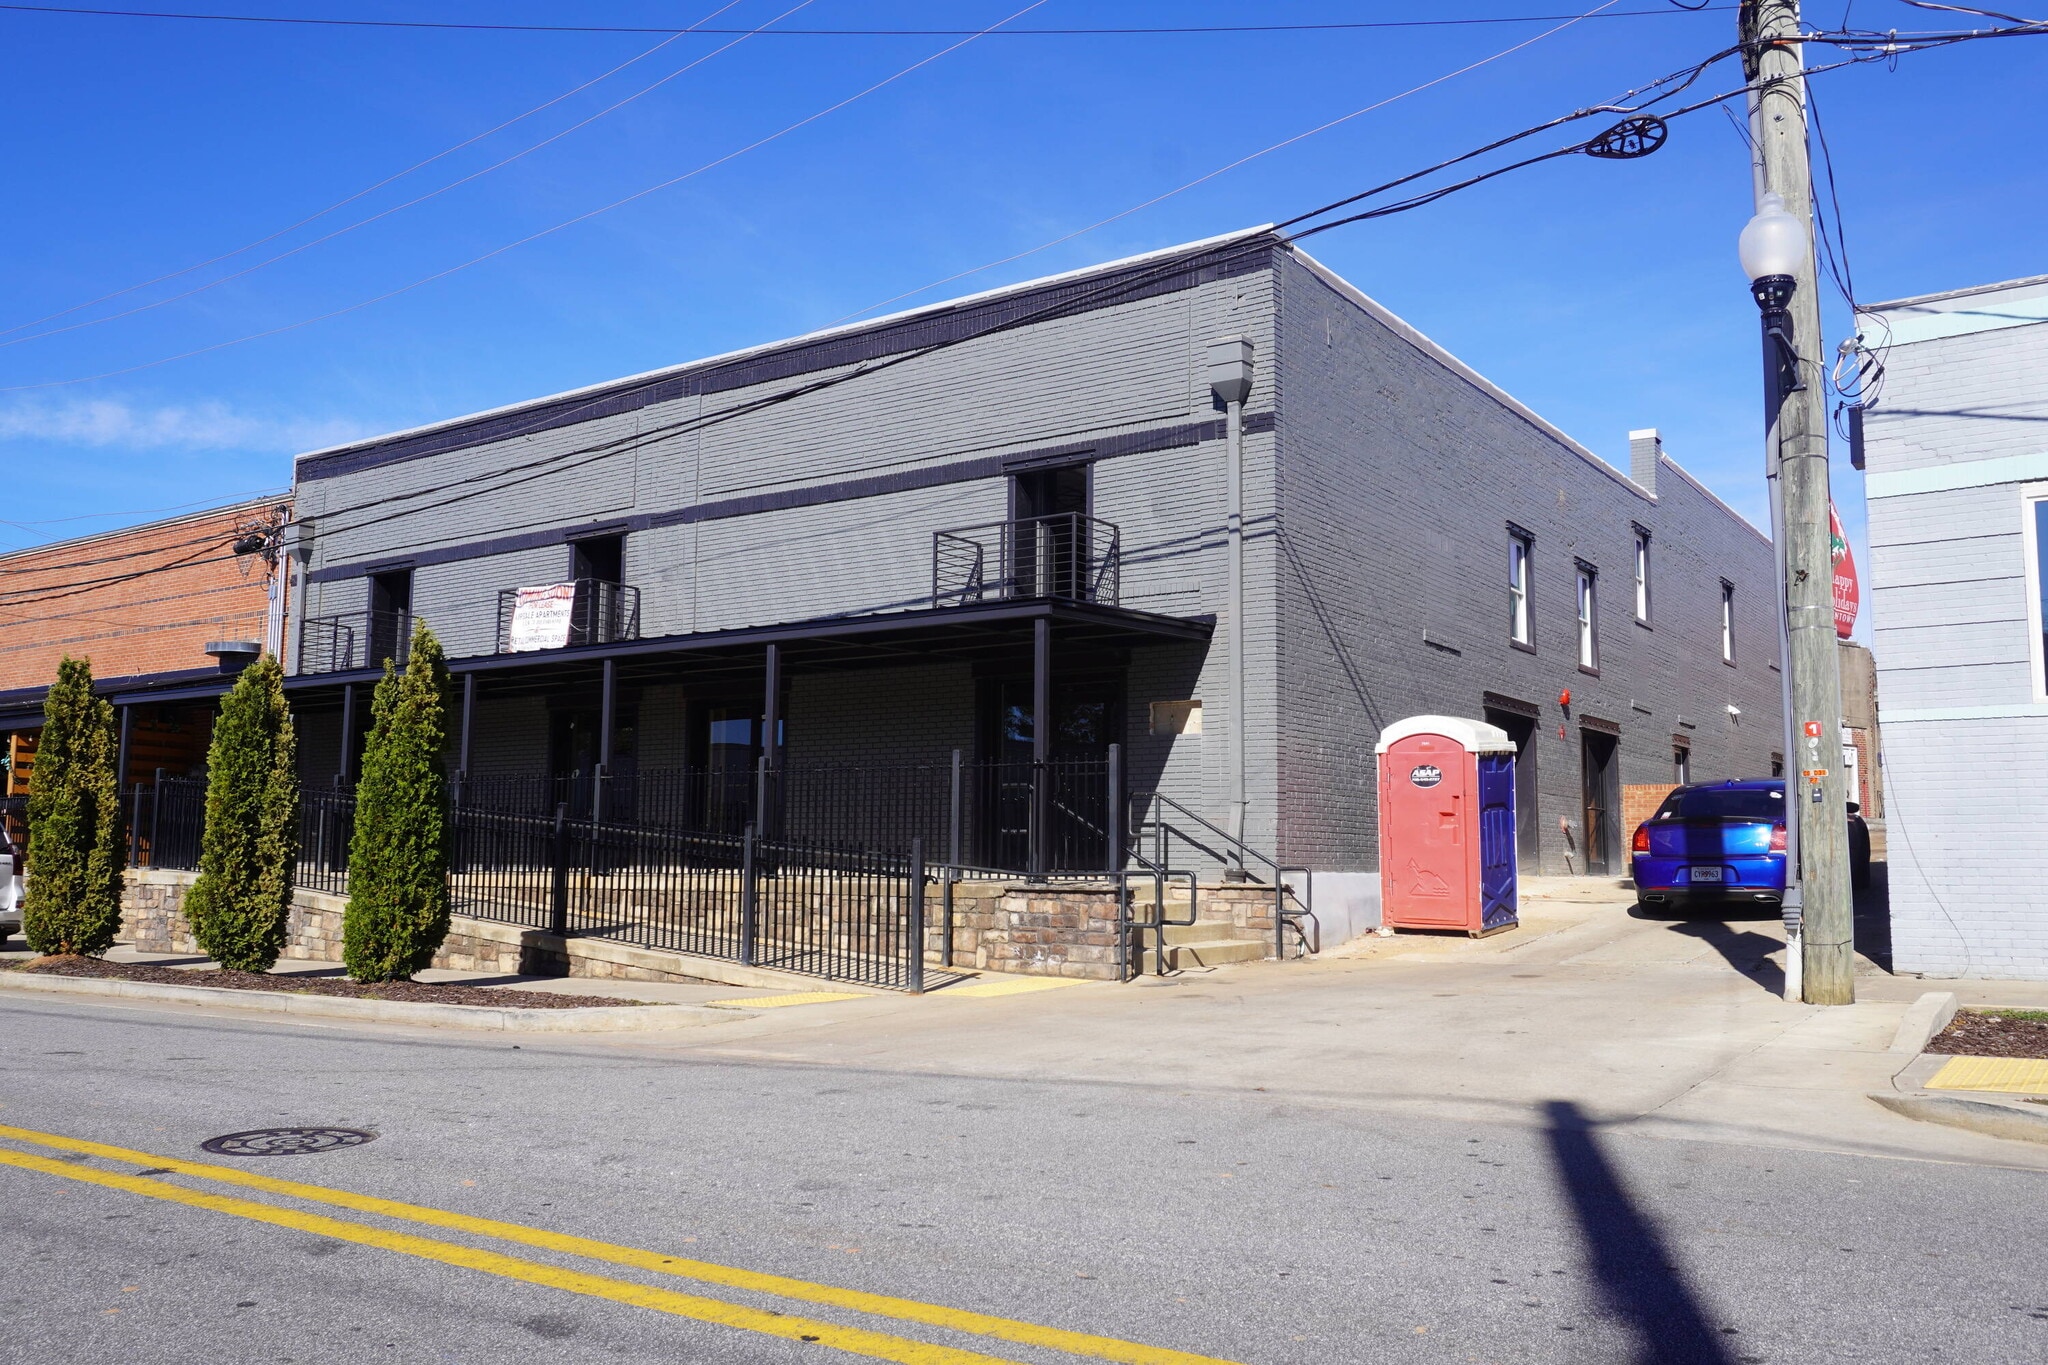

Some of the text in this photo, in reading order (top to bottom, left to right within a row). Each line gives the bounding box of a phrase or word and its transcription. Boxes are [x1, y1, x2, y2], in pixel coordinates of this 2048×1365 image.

[1832, 586, 1858, 612] olidays
[536, 609, 570, 618] APARTMENTS
[1834, 612, 1854, 624] NTOWN
[1808, 723, 1818, 735] 1
